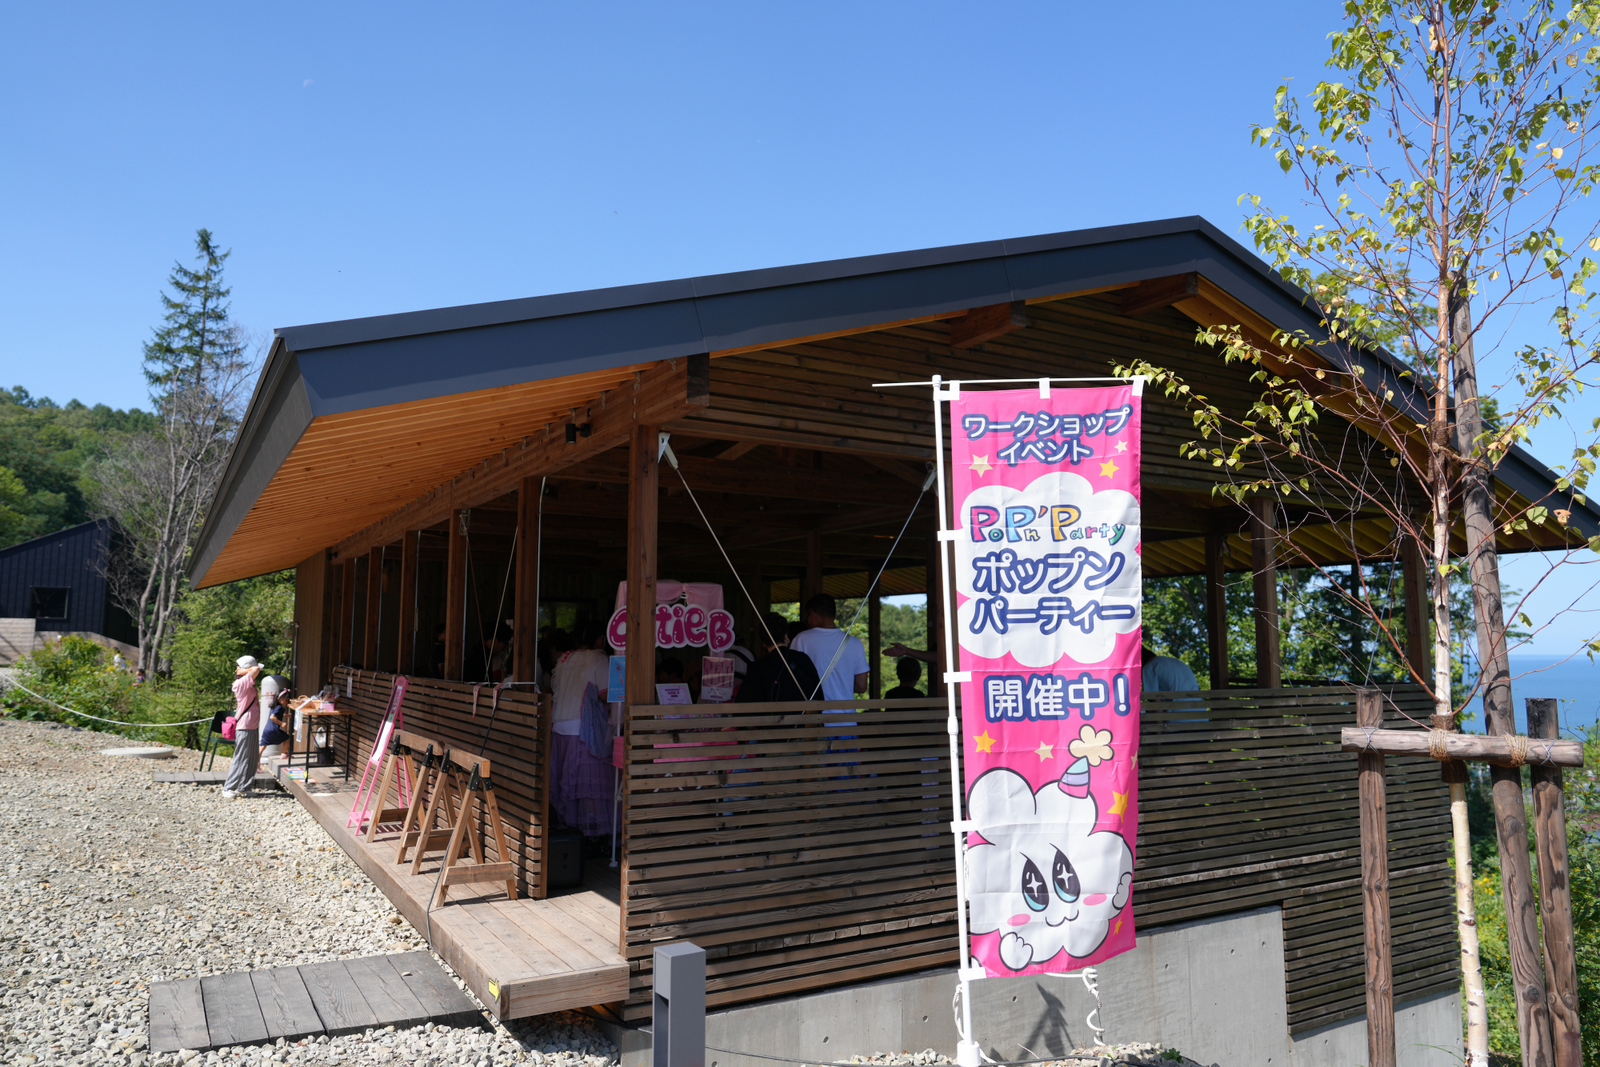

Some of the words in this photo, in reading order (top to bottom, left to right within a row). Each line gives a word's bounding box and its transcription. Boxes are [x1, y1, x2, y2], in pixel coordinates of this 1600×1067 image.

[963, 405, 1132, 439] ワークショップ
[998, 439, 1093, 466] イベント
[1051, 504, 1125, 546] Party
[972, 547, 1125, 595] ポップン
[970, 596, 1135, 635] パーティー
